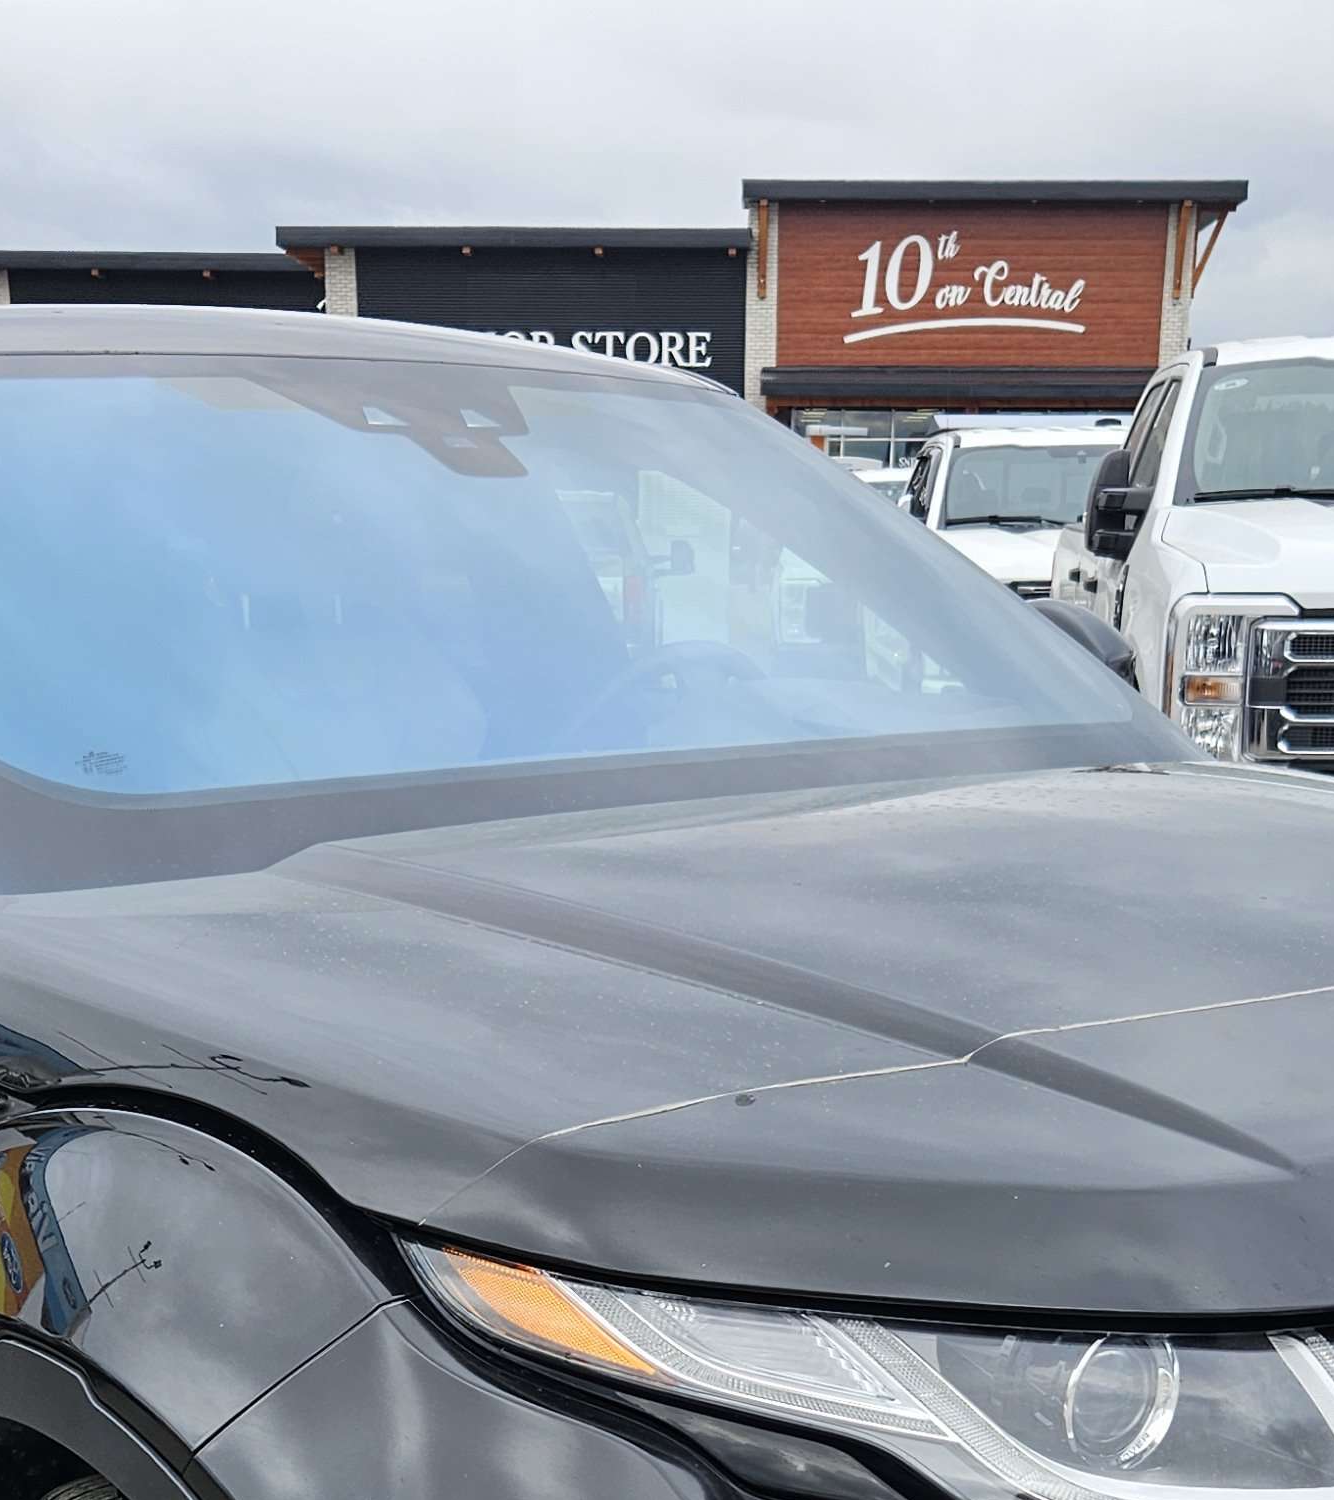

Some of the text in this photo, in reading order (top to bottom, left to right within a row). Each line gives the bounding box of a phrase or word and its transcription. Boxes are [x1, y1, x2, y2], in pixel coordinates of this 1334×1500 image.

[851, 231, 1086, 318] 10th on Central
[571, 331, 714, 367] STORE
